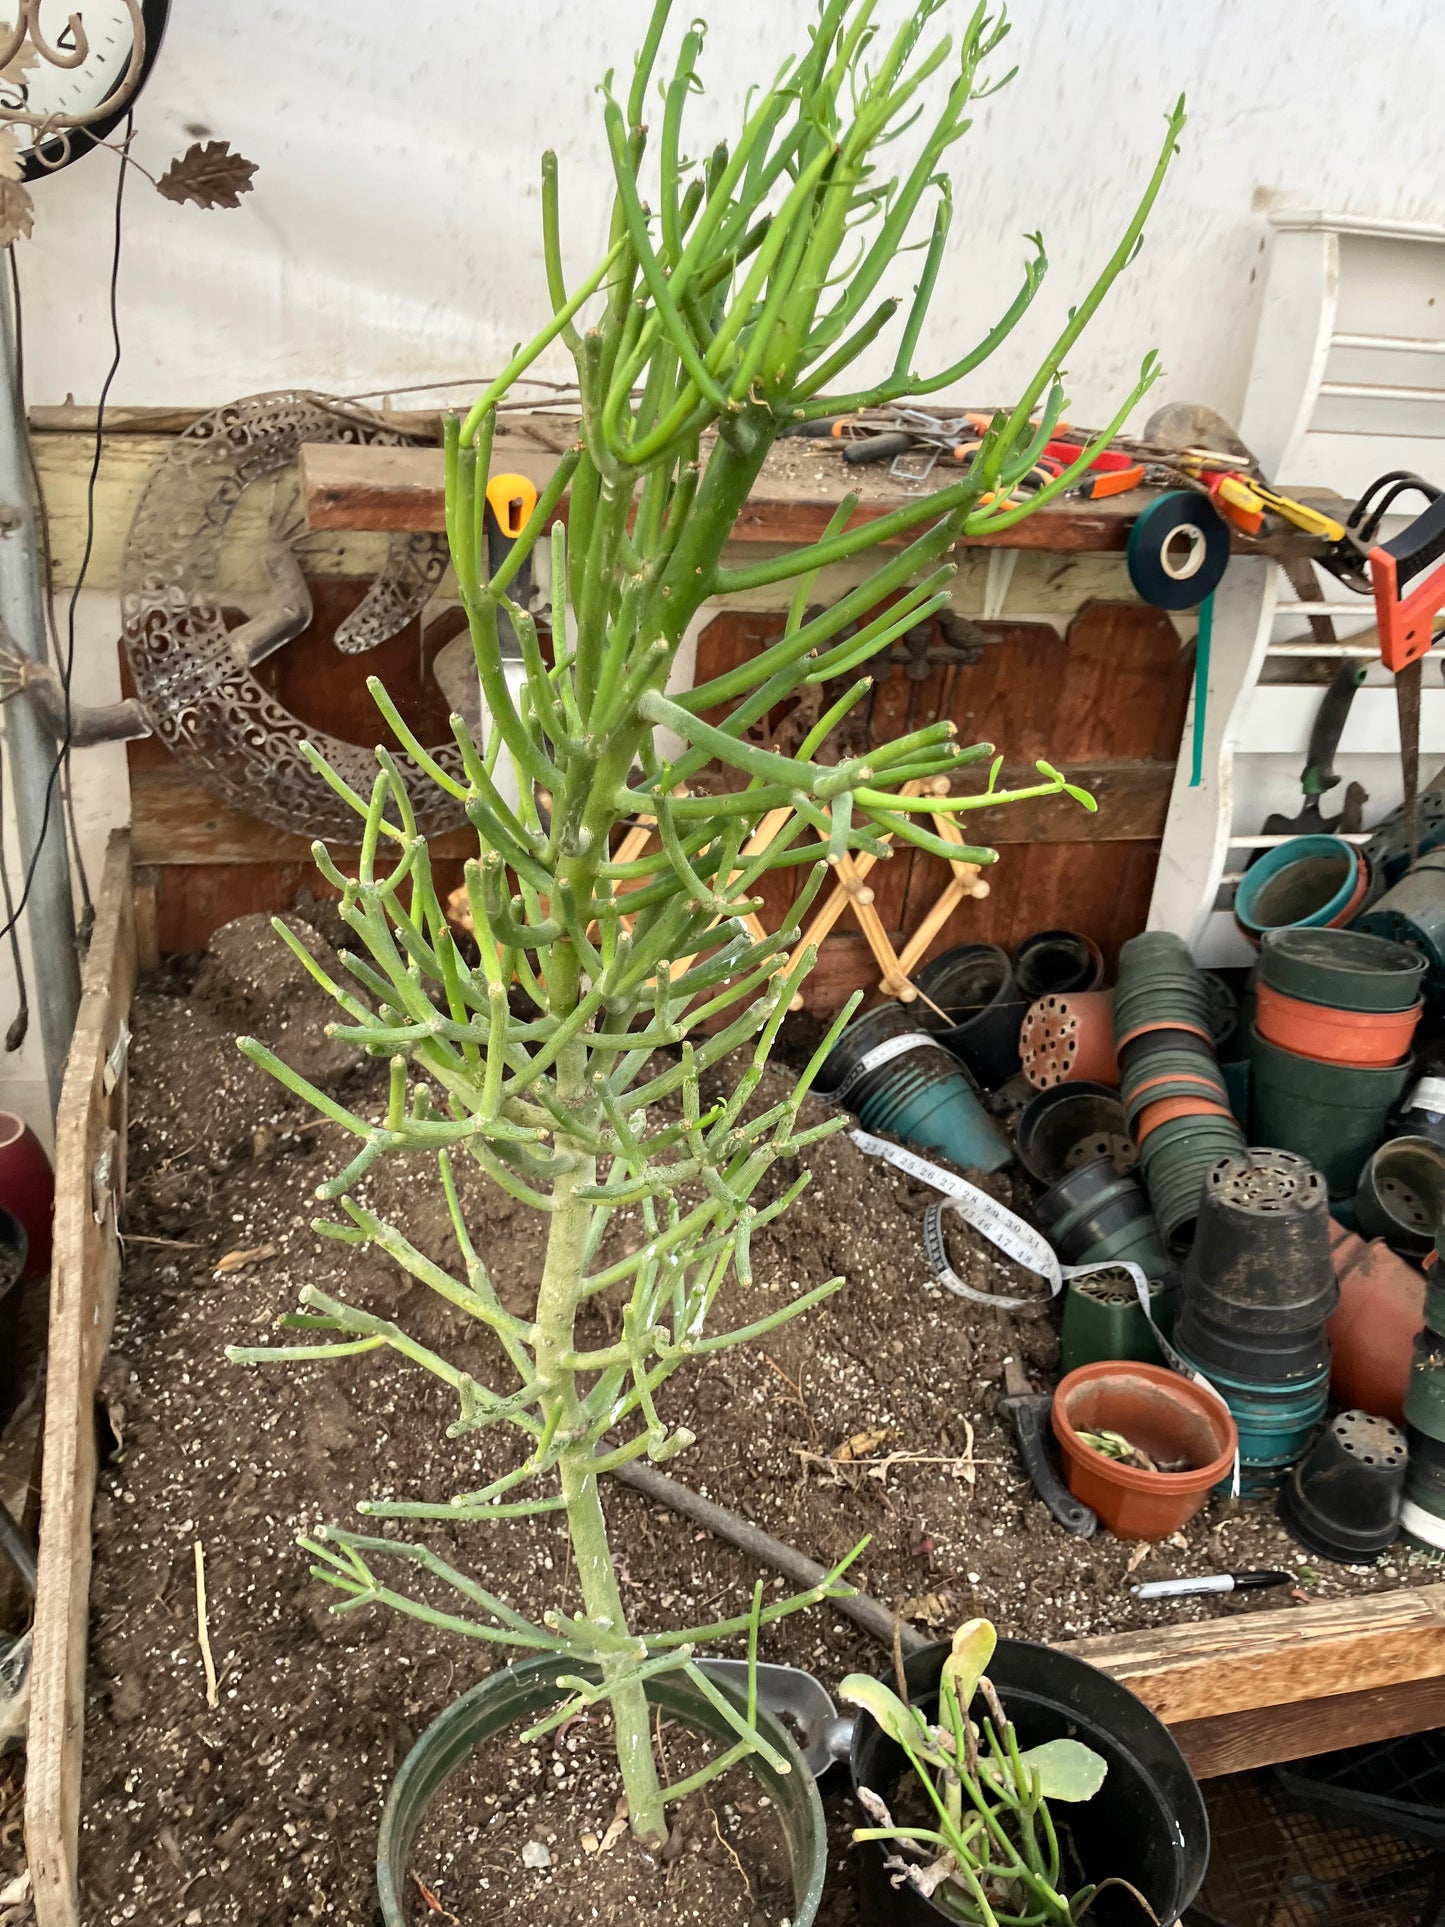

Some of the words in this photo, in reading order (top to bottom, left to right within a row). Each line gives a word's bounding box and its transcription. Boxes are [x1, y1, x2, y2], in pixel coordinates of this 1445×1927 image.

[900, 1156, 915, 1170] 25
[919, 1167, 934, 1180] 26
[939, 1177, 956, 1191] 27
[961, 1189, 978, 1204] 28
[984, 1203, 999, 1218] 29
[1004, 1218, 1022, 1233] 30
[1026, 1234, 1040, 1249] 31
